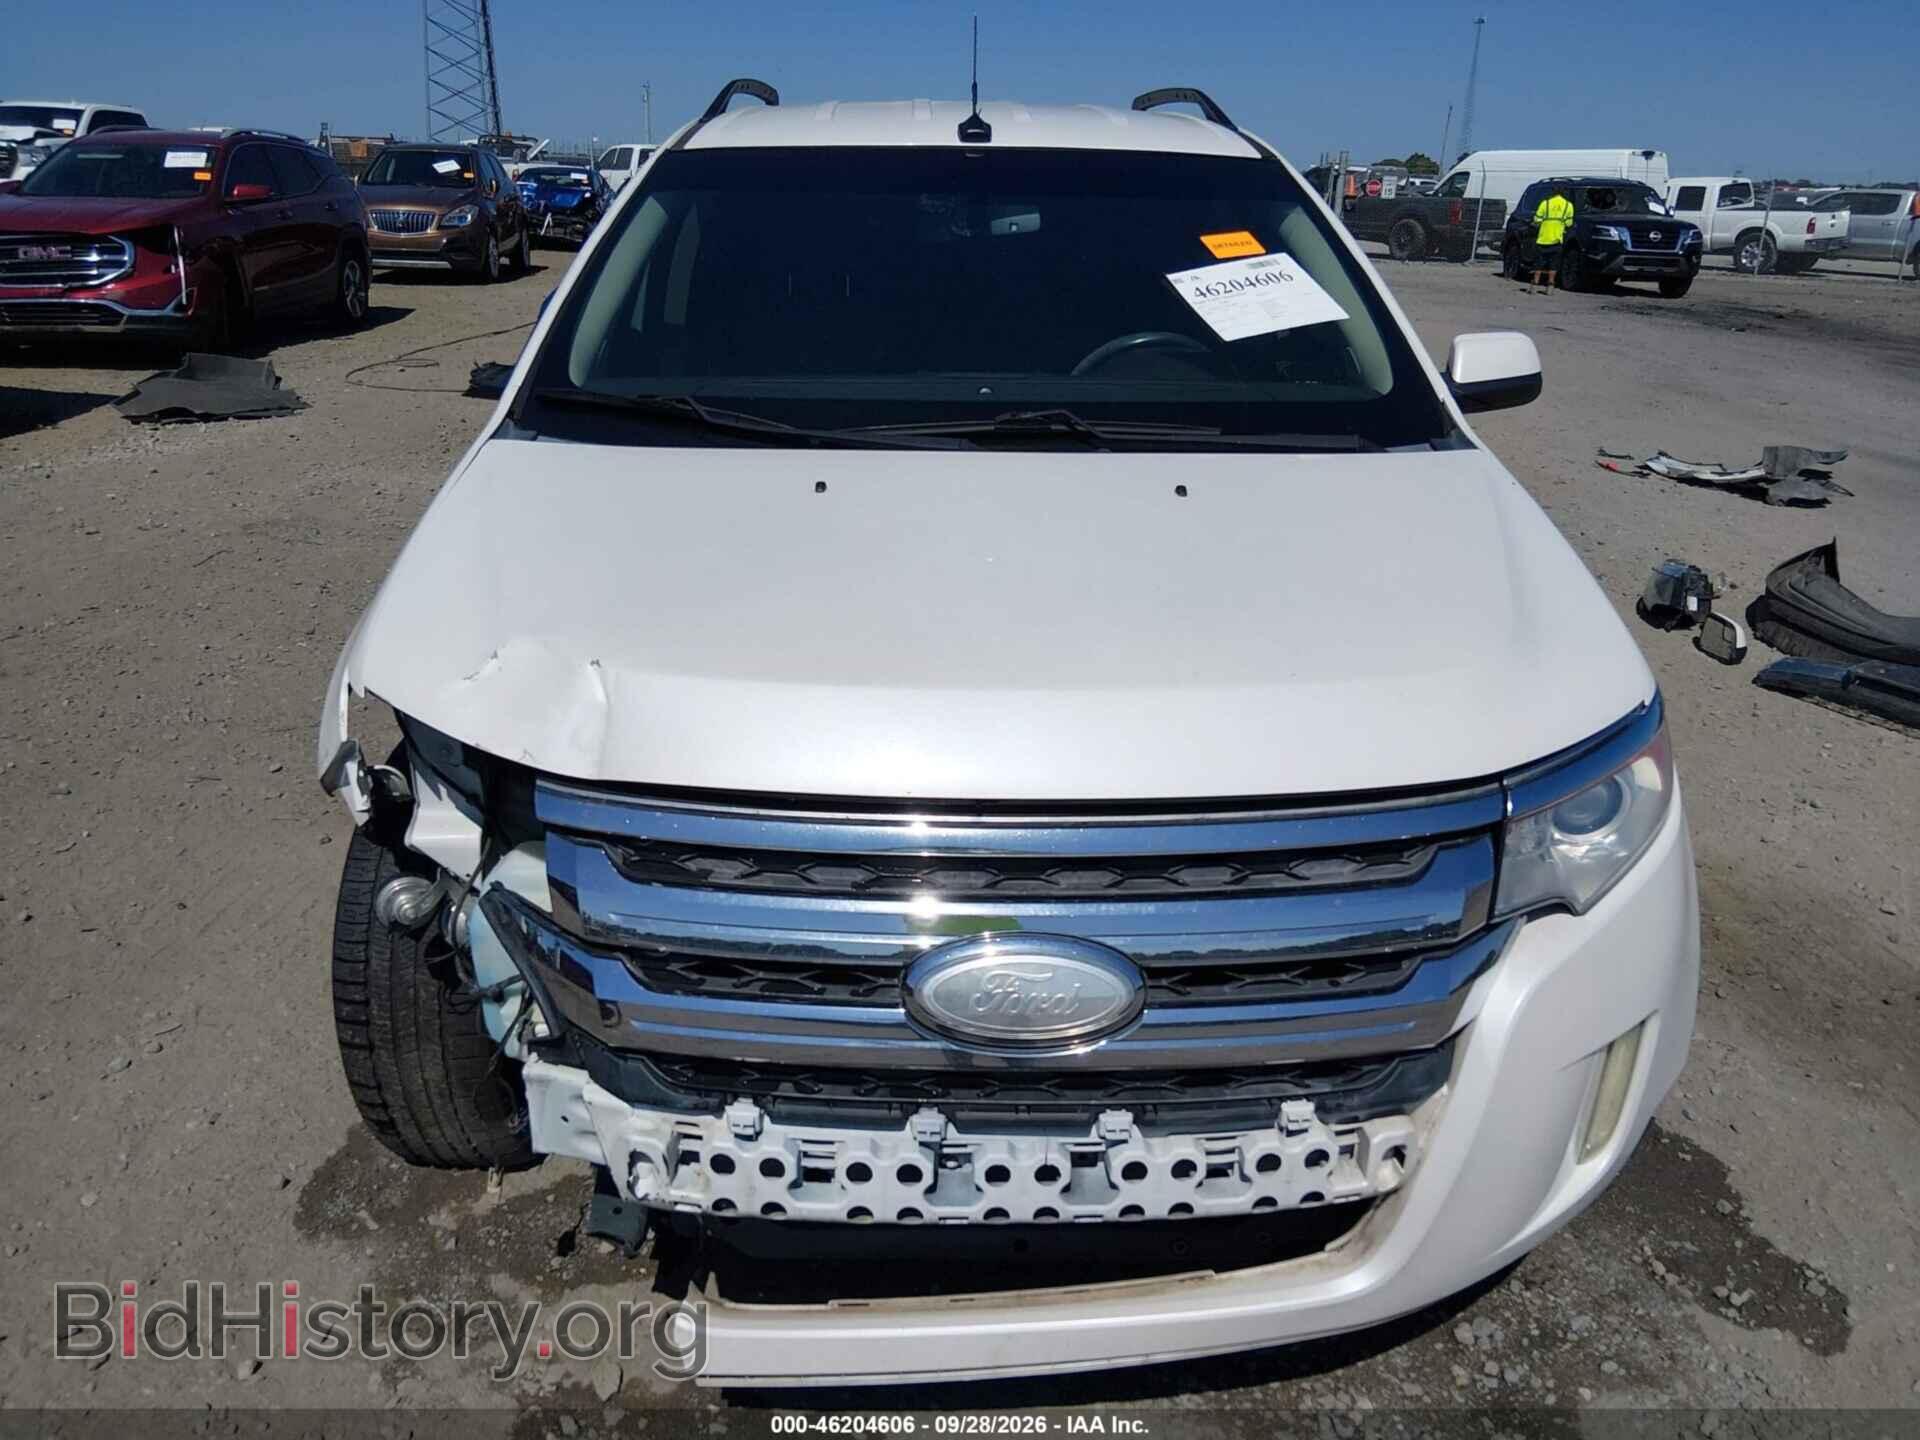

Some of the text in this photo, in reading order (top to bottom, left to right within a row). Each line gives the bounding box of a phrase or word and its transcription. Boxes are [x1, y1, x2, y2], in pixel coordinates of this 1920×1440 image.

[17, 246, 72, 260] GMC
[1193, 269, 1294, 300] 46204606
[969, 969, 1081, 1016] Ford
